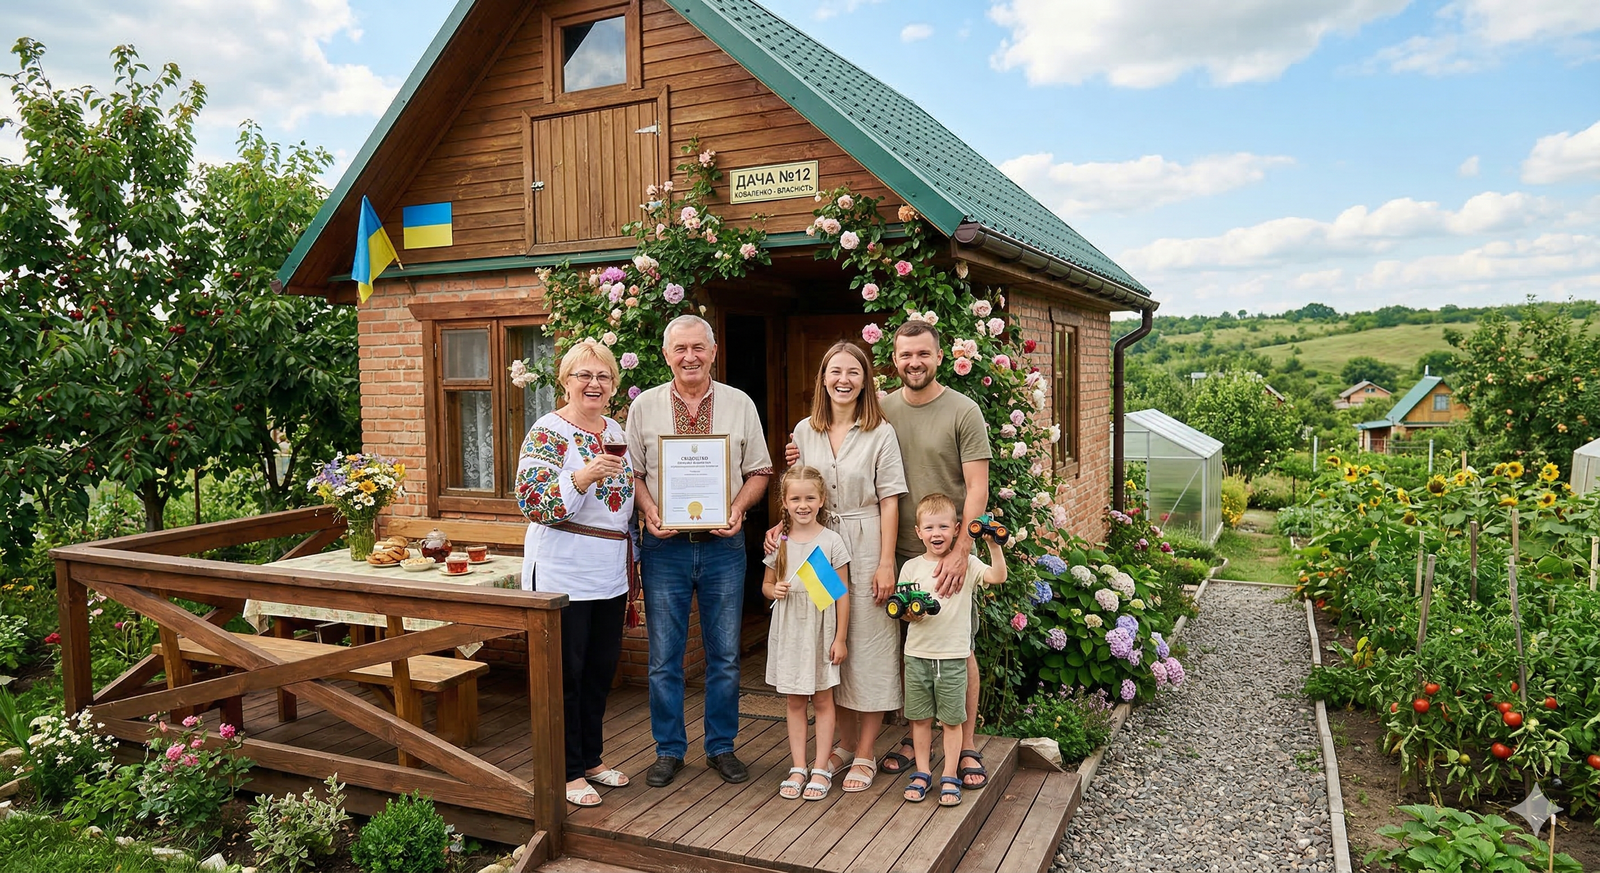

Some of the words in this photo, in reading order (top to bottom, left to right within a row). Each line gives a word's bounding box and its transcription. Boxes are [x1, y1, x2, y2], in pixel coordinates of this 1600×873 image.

[736, 172, 775, 190] ДАЧА
[779, 167, 810, 183] №12
[777, 184, 813, 194] ВЛАСНІСТЬ
